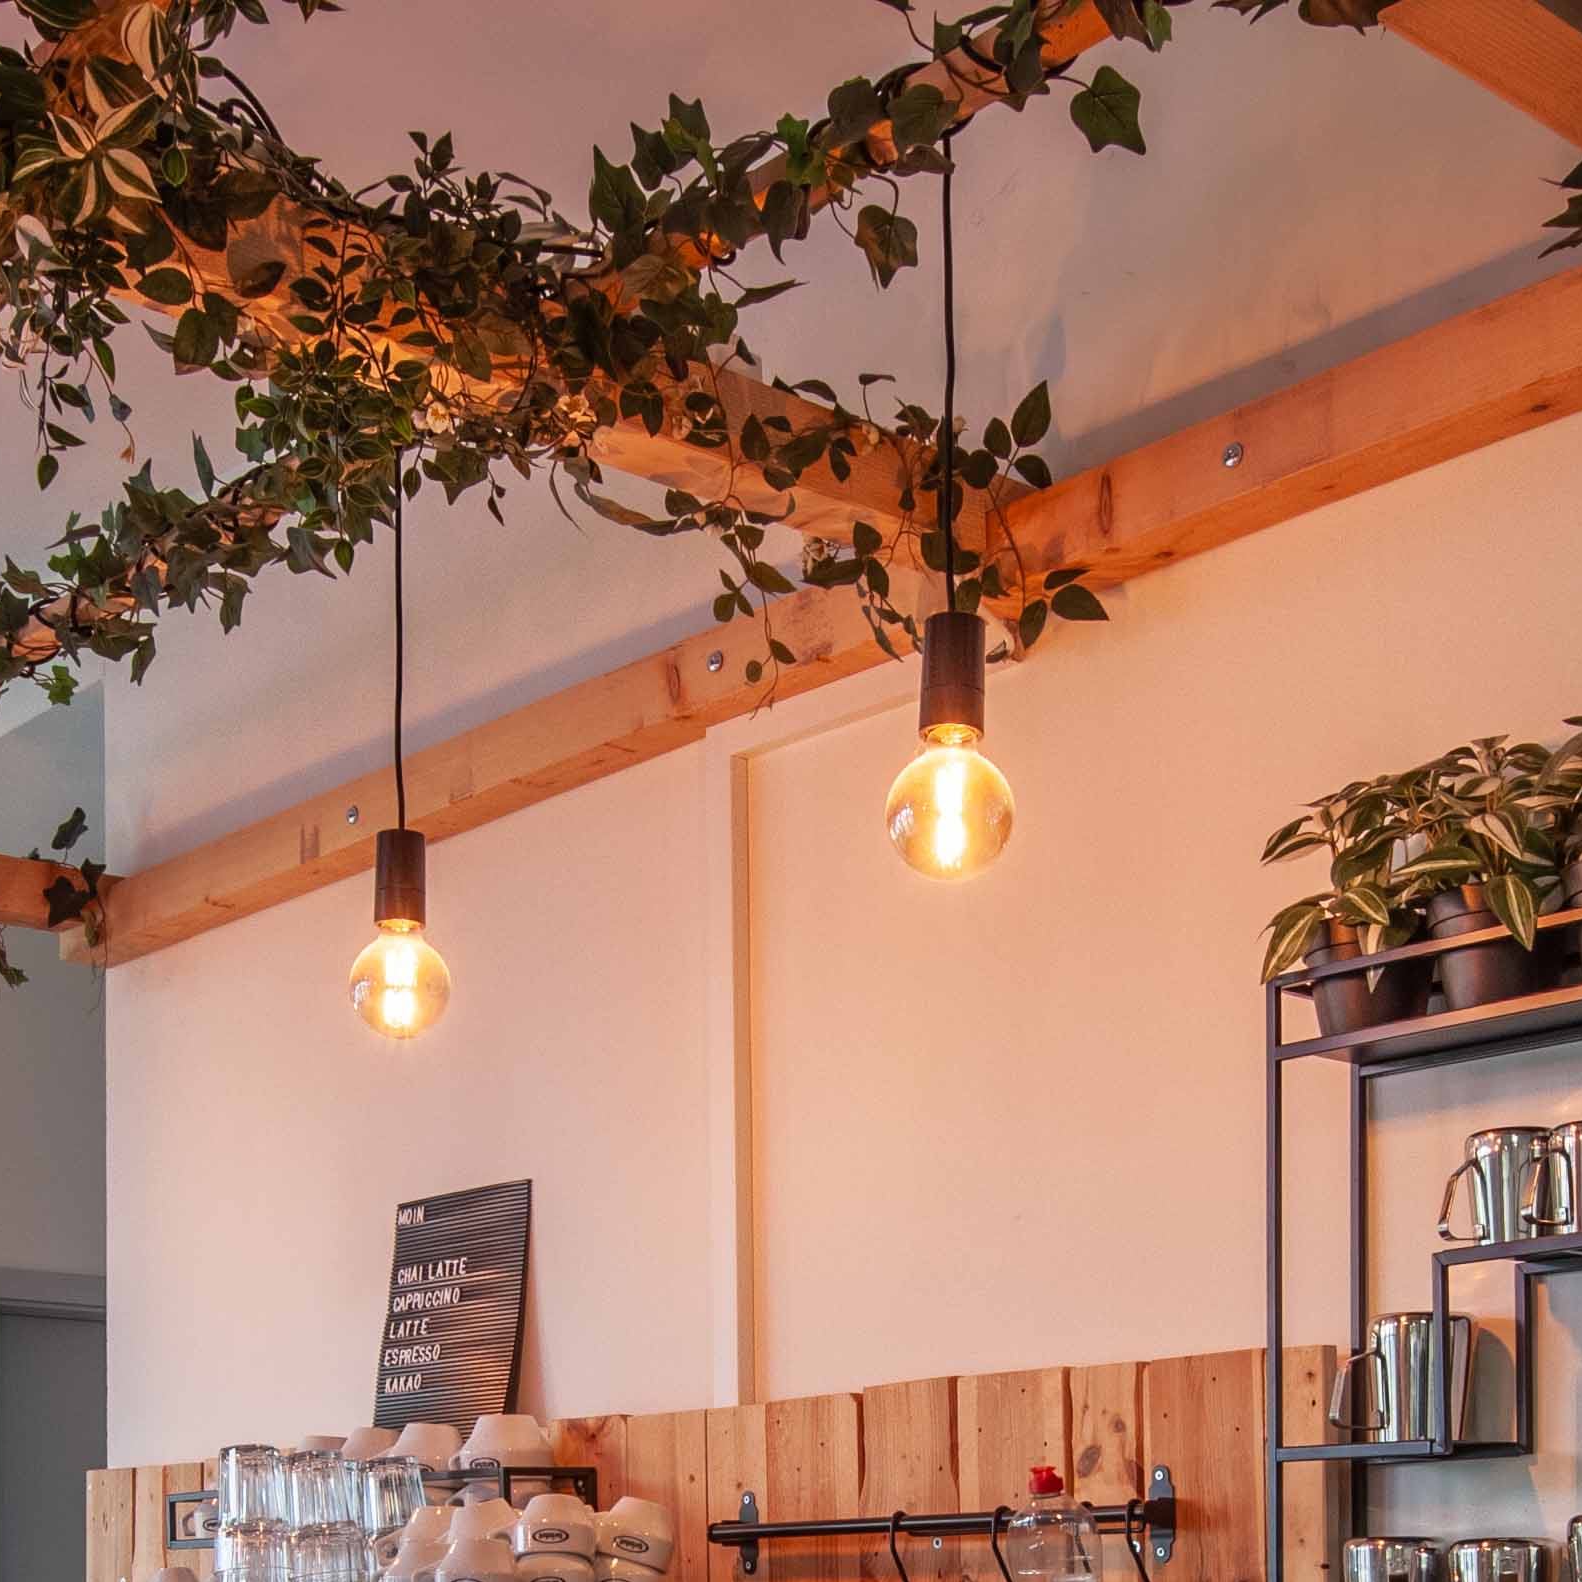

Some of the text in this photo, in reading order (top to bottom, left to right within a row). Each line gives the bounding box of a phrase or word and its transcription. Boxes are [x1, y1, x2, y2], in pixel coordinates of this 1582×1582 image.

[398, 1205, 425, 1226] MOIN
[398, 1257, 467, 1285] CHAI LATTE
[393, 1287, 461, 1313] CAPPUCCINO
[389, 1318, 430, 1339] LATTE
[384, 1344, 441, 1366] ESPRESSO
[385, 1374, 422, 1393] KAKAO
